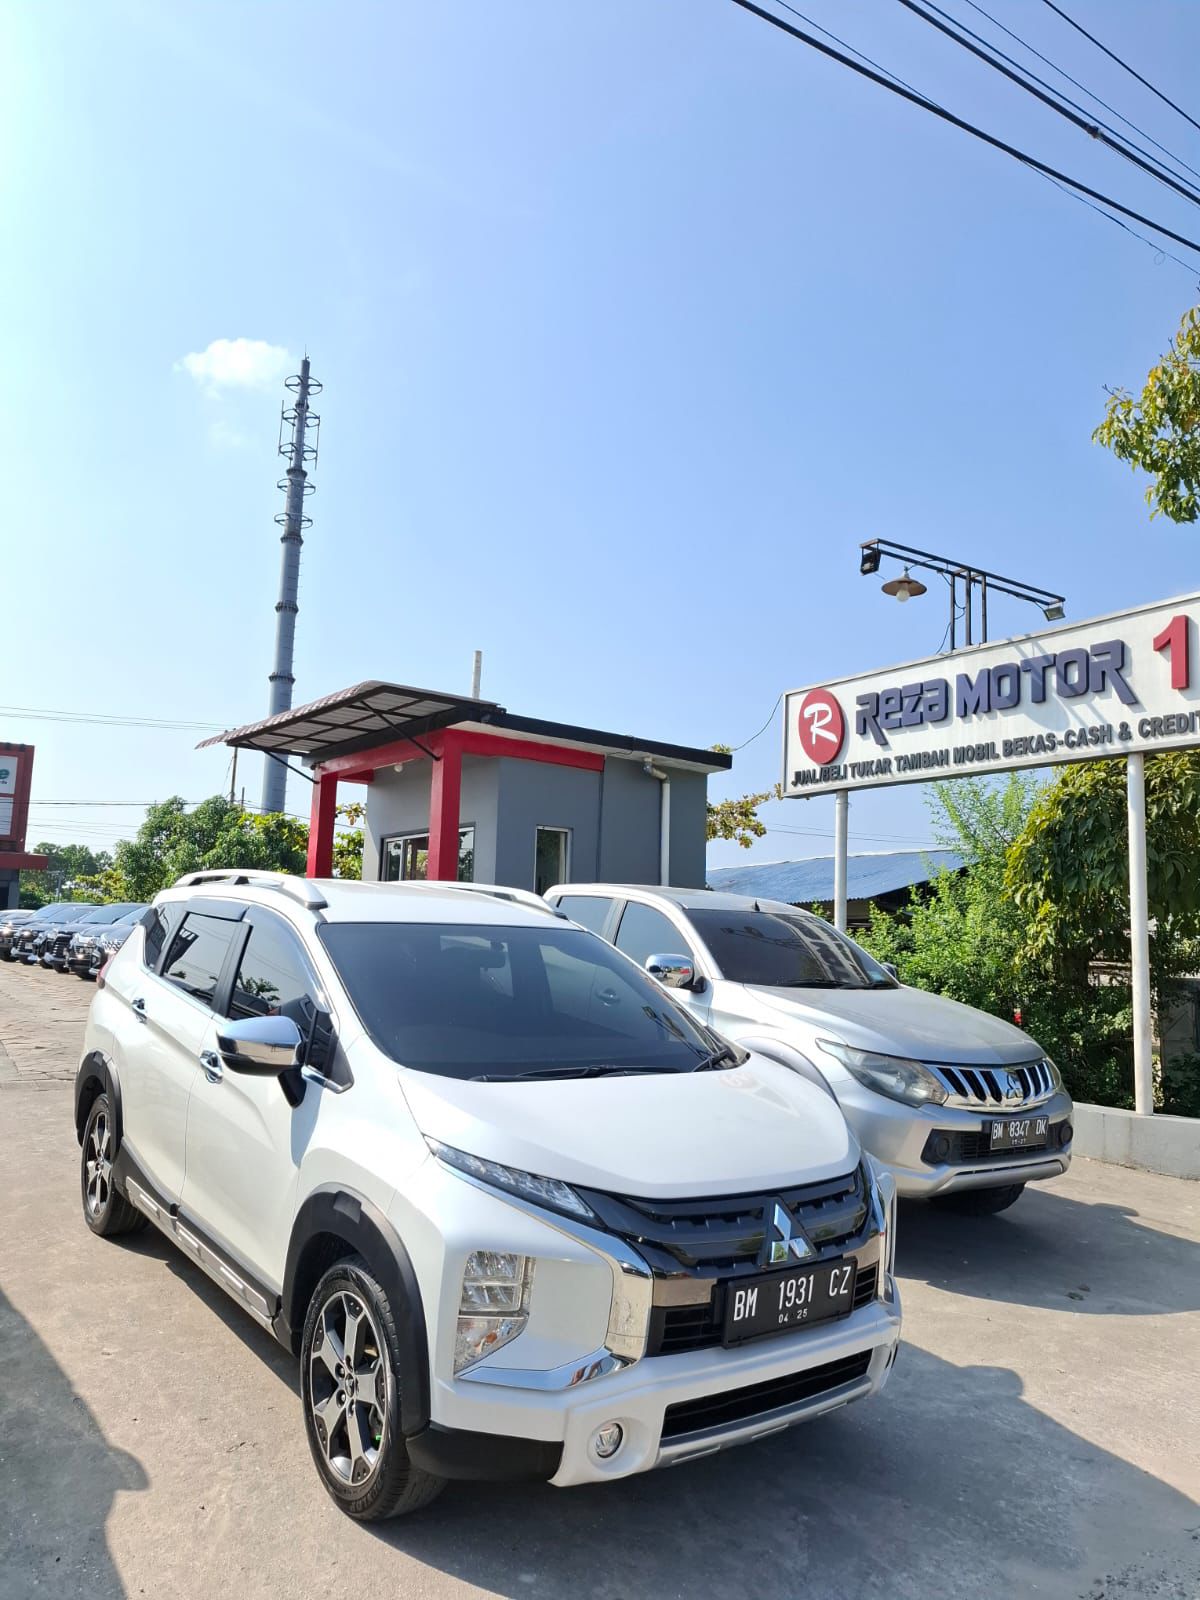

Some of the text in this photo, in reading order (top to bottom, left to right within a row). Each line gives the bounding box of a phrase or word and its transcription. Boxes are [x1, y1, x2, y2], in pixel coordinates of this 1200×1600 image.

[956, 639, 1138, 718] MOTOR
[1153, 614, 1189, 690] 1
[804, 703, 838, 744] R
[849, 758, 893, 779] TUKAR
[894, 749, 949, 772] TAMBAH
[953, 742, 1000, 765] MOBIL
[1118, 721, 1132, 740] &
[993, 1119, 1047, 1139] BM 8347 DK
[734, 1266, 851, 1321] BM 1931 CZ
[778, 1308, 807, 1323] 04 25
